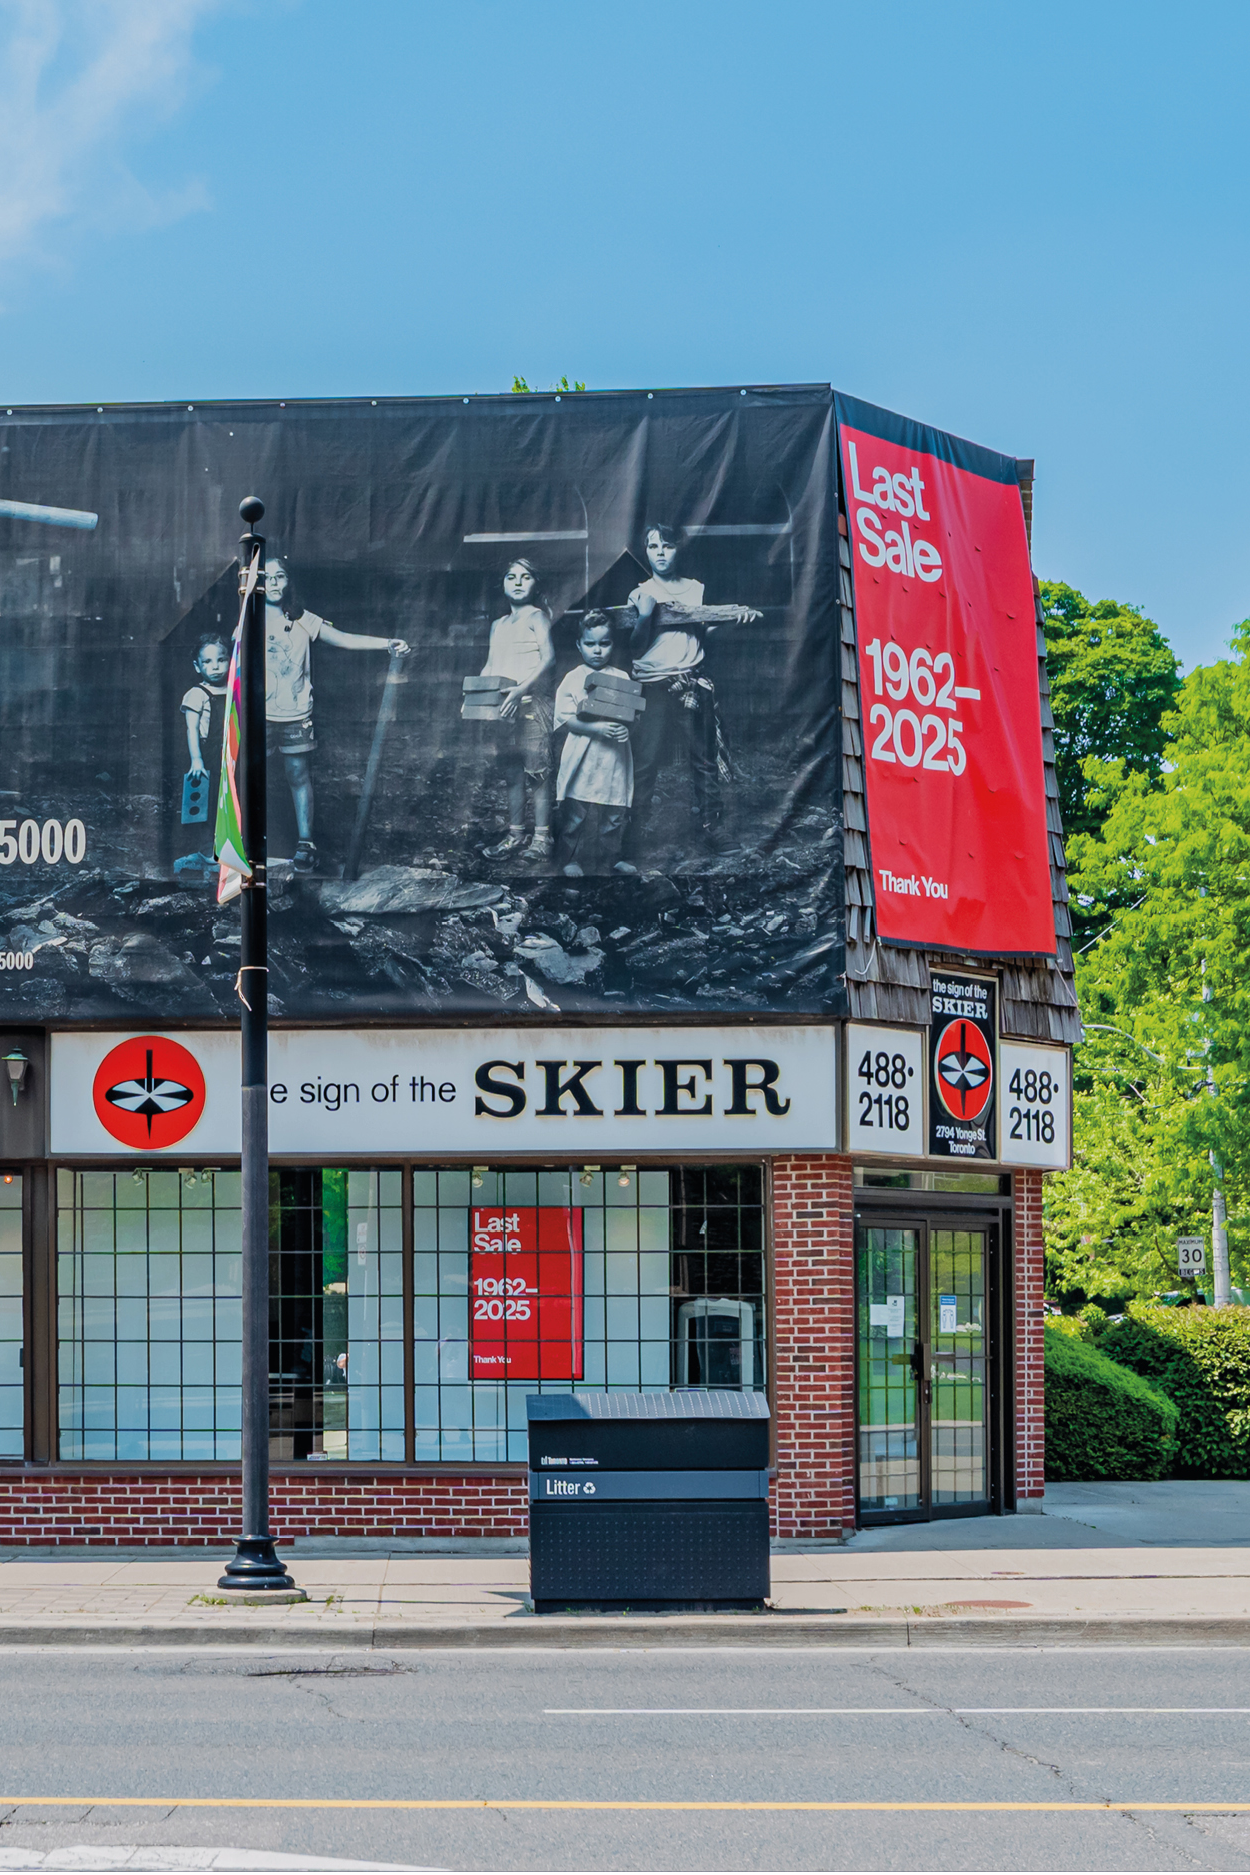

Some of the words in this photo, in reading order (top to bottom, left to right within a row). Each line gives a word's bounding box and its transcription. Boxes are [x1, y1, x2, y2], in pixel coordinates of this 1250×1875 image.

[848, 441, 931, 521] Last
[855, 507, 943, 583] Sale
[870, 703, 967, 777] 2025
[879, 869, 921, 896] Thank
[921, 875, 948, 899] You
[932, 979, 946, 993] the
[947, 981, 964, 998] sign
[964, 984, 973, 997] of
[973, 984, 988, 999] the
[932, 996, 988, 1019] SKIER
[299, 1076, 360, 1111] sign
[371, 1074, 400, 1102] of
[409, 1076, 457, 1102] the
[474, 1058, 792, 1119] SKIER
[859, 1091, 910, 1131] 2118
[935, 1125, 955, 1139] 2794
[955, 1127, 978, 1142] Yonge
[1009, 1106, 1055, 1144] 2118
[948, 1140, 976, 1155] Toronto
[474, 1212, 520, 1232] Last
[474, 1233, 522, 1255] Sale
[1182, 1249, 1202, 1263] 30
[474, 1299, 531, 1321] 2025
[473, 1355, 497, 1364] Thank
[546, 1479, 581, 1495] Litter
